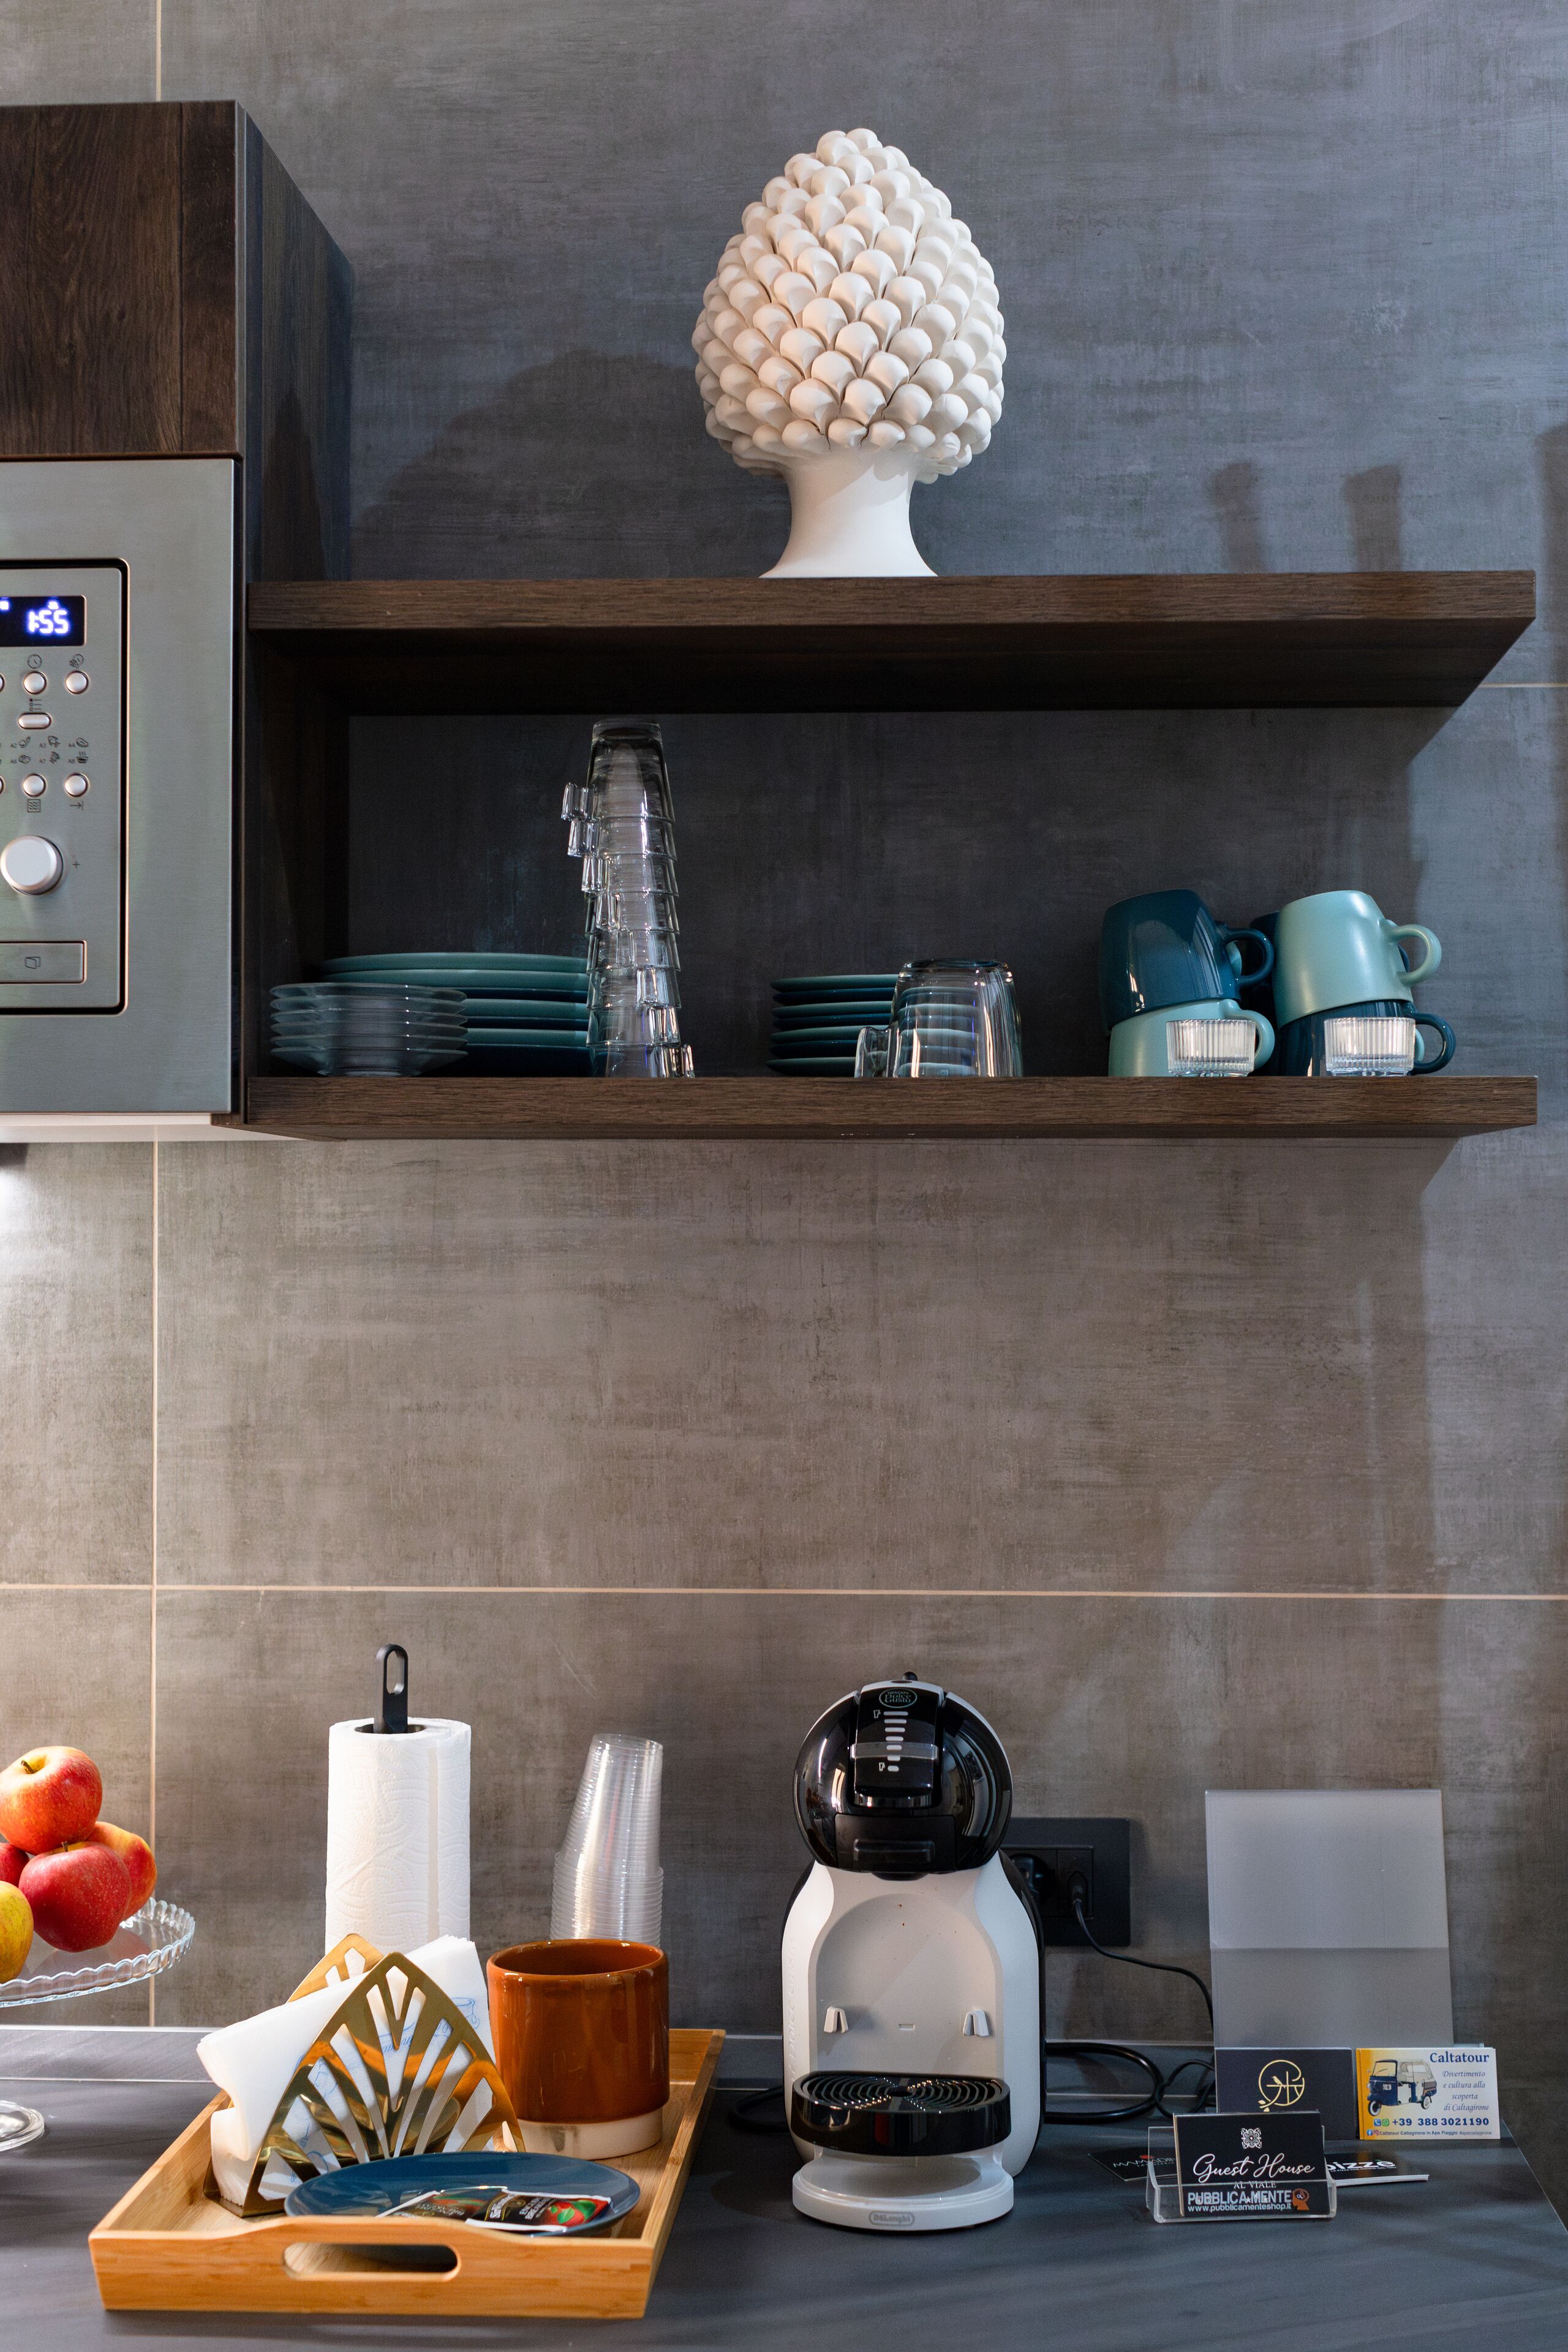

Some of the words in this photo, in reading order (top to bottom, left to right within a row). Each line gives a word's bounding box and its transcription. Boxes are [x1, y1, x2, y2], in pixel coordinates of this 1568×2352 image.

[28, 609, 69, 634] 1:55
[1430, 2051, 1489, 2063] Caltatour
[1452, 2103, 1489, 2113] Caltagirone
[1441, 2117, 1490, 2126] 3021190
[1193, 2154, 1254, 2183] Guest
[1253, 2153, 1315, 2178] House
[1234, 2180, 1246, 2189] AL
[1188, 2203, 1292, 2213] www.pubblicamenteshop.it
